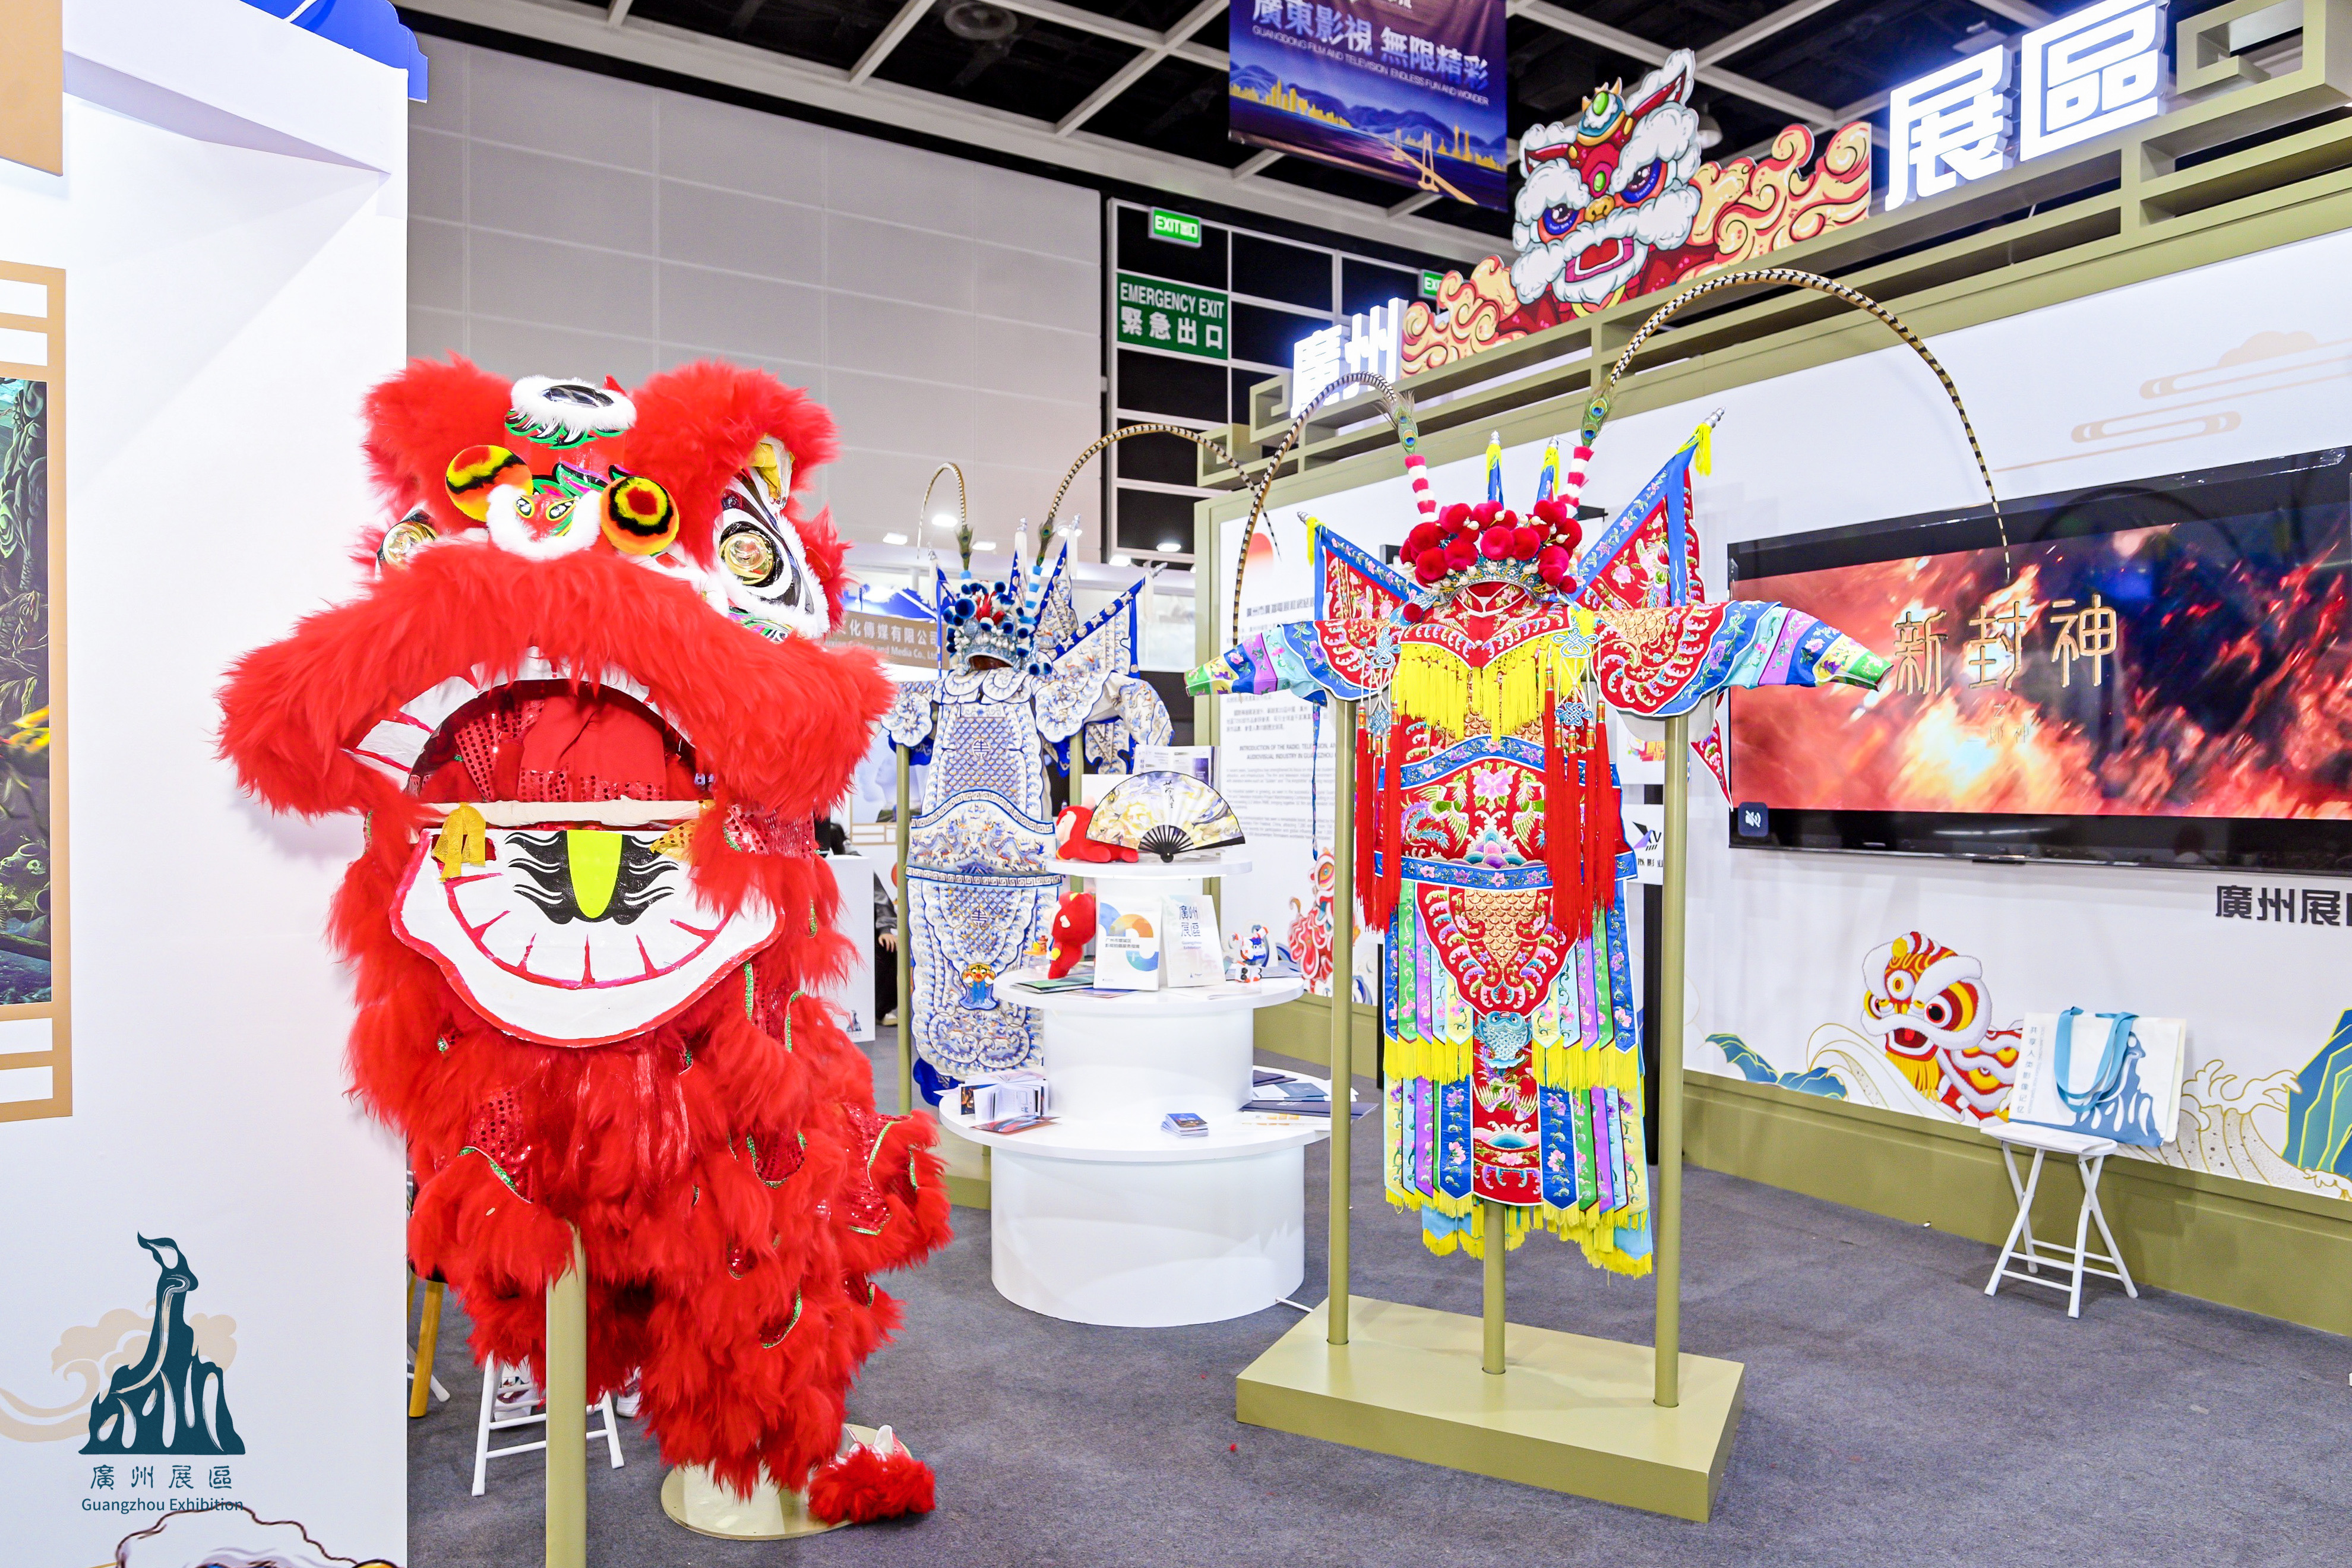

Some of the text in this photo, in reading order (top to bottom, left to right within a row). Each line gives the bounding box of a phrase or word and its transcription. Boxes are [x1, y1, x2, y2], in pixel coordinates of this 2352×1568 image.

[1252, 0, 1489, 91] 廣東影視 無限精彩
[1252, 25, 1489, 107] GUANGDONG FILM AND TELEVISION ENDLESS FUN AND WONDER
[1885, 0, 2159, 211] 展區
[1154, 214, 1181, 233] EXIT
[1120, 282, 1225, 319] EMERGENCY EXIT
[1120, 305, 1224, 350] 緊急出口
[1290, 297, 1400, 419] 廣州
[844, 618, 937, 646] 化傳媒有限公司
[1894, 594, 2118, 696] 新封神
[1179, 905, 1199, 920] 廣州
[2216, 885, 2352, 927] 廣州展
[1181, 922, 1202, 937] 展區
[90, 1464, 233, 1490] 廣州展區
[81, 1498, 244, 1515] Guangzhou Exhibition
